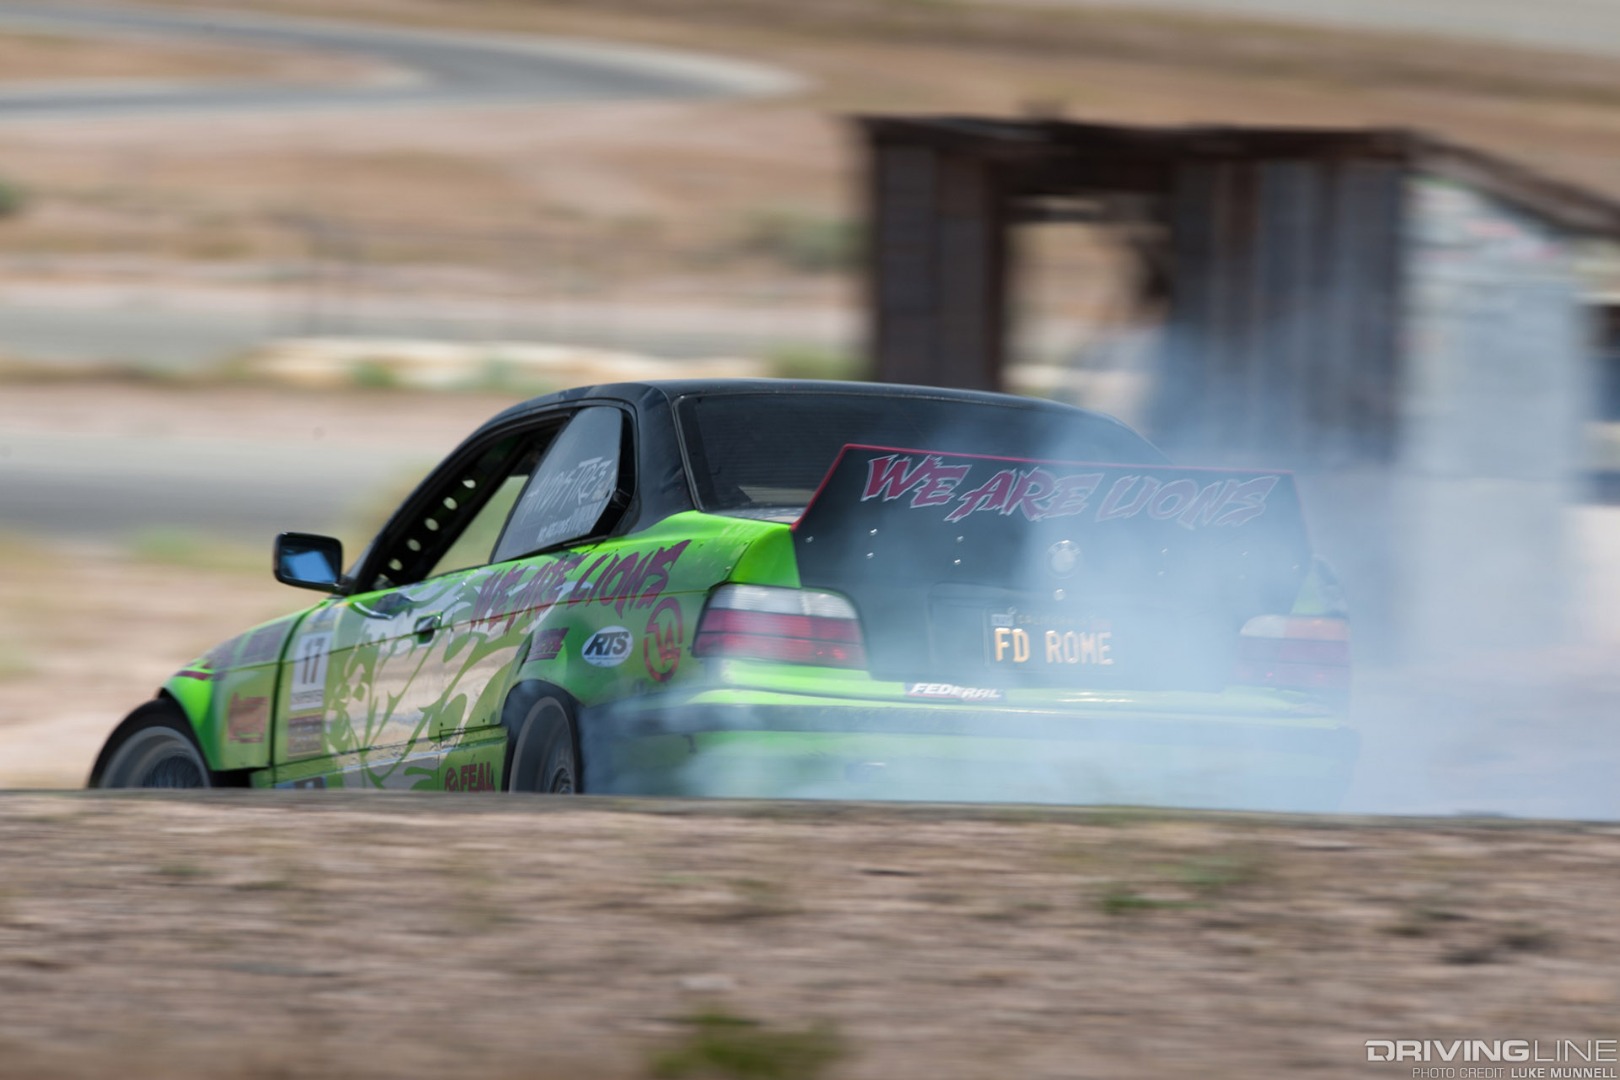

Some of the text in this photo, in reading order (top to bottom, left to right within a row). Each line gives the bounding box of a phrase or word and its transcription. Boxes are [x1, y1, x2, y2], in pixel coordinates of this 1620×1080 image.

[860, 455, 1280, 530] WE ARE LIONS
[469, 539, 693, 637] WE ARE LIONS
[301, 637, 326, 685] 17
[584, 631, 630, 656] RTS
[994, 627, 1115, 665] FD ROME
[910, 682, 1002, 699] FEDERAL
